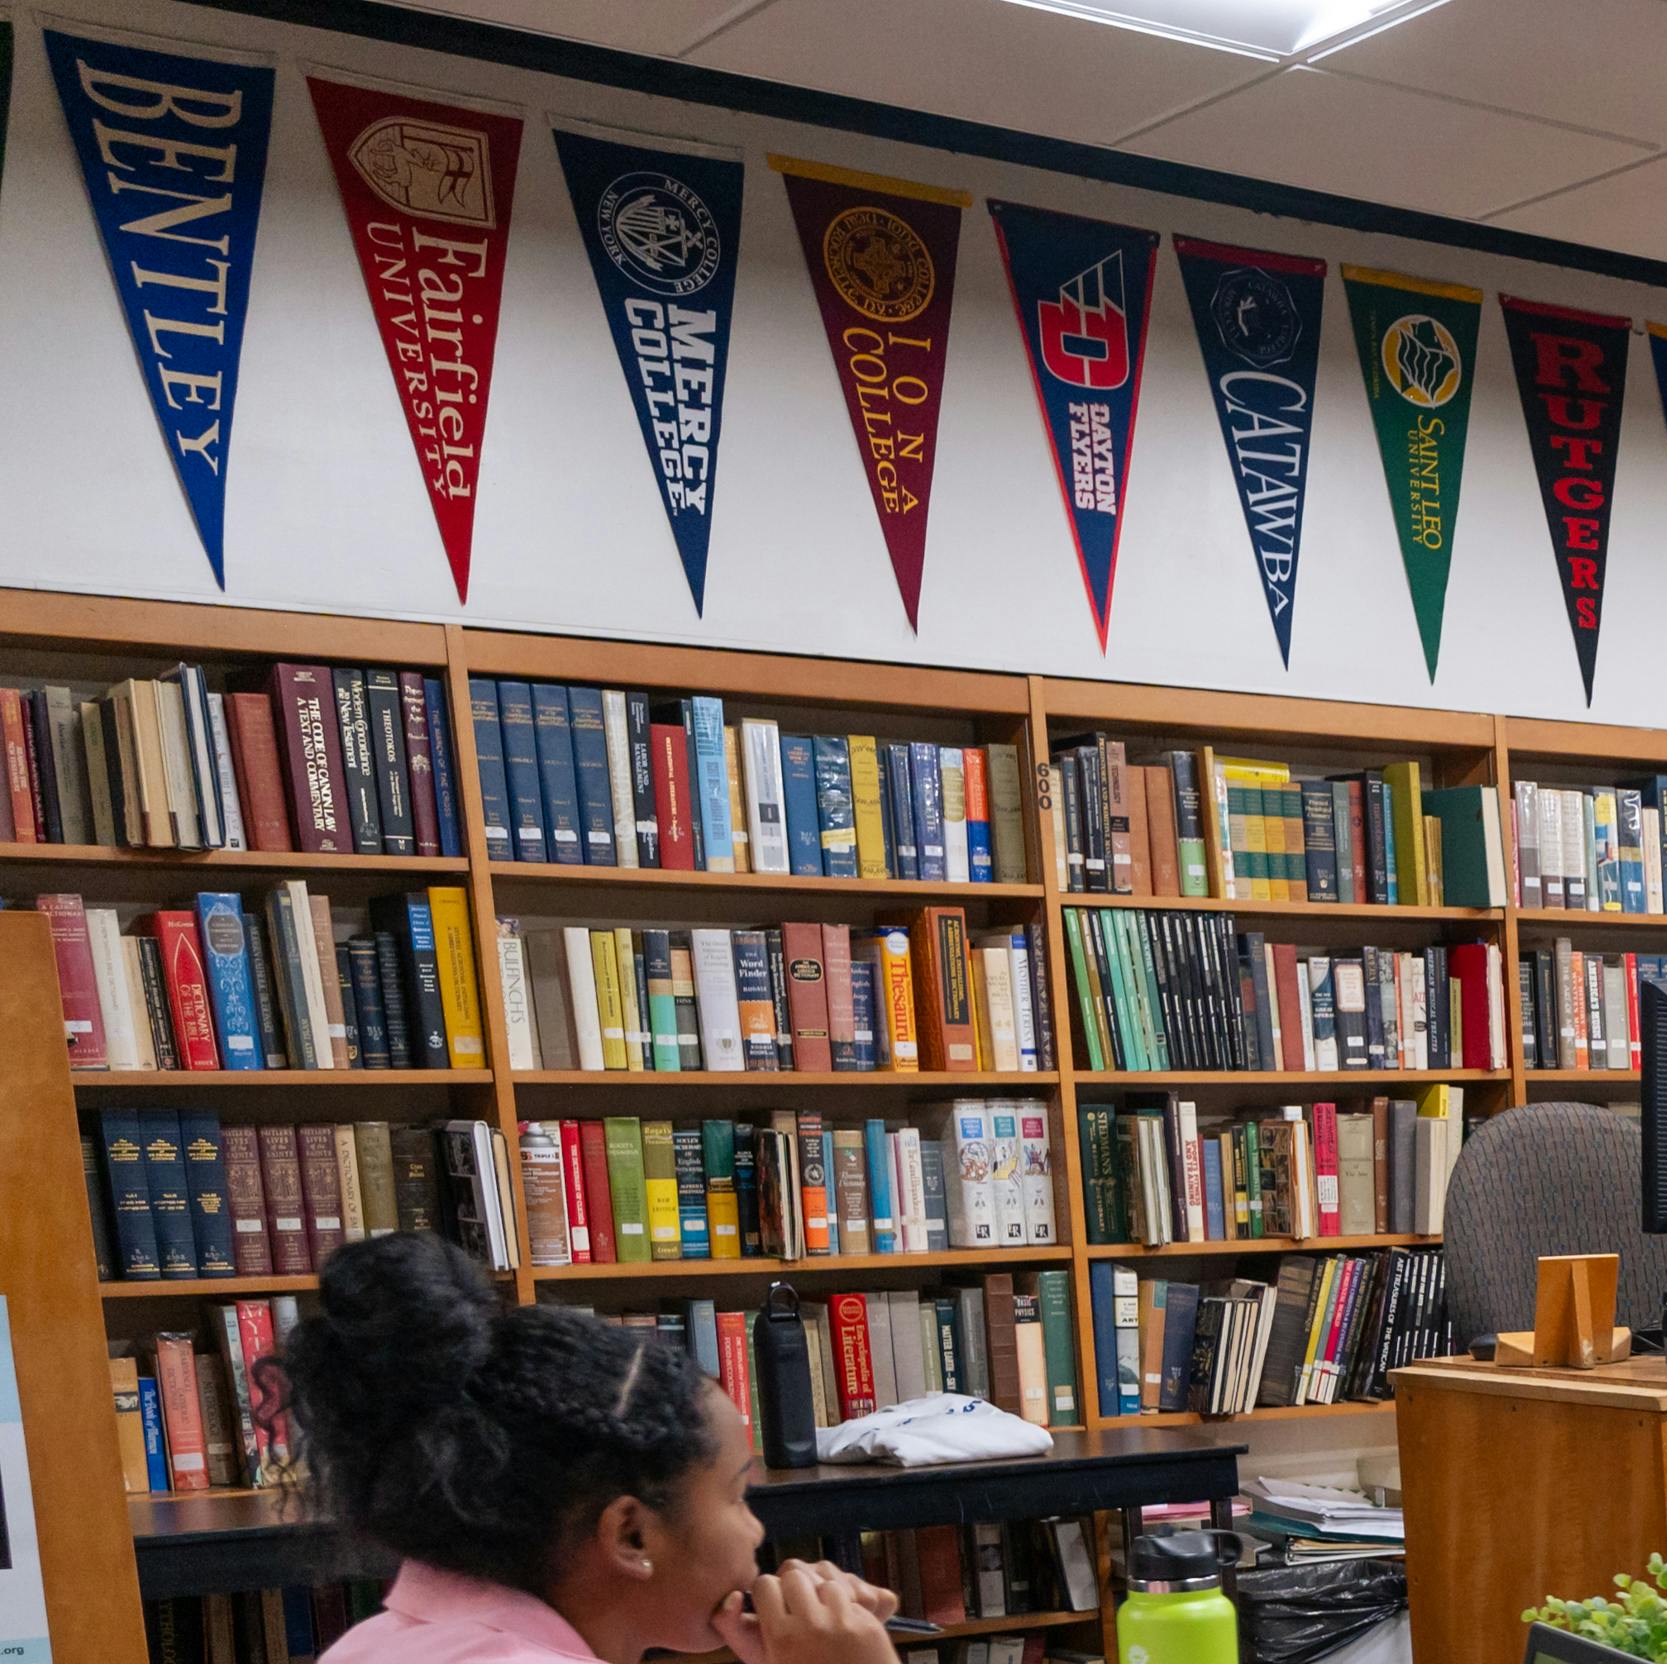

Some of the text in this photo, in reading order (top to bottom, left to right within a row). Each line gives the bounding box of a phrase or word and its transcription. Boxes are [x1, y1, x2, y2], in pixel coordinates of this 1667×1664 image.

[76, 58, 243, 476] BENTLEY
[600, 215, 625, 266] YORK
[664, 178, 721, 295] MERCY COLLEGE
[367, 221, 446, 498] UNIVERSITY
[411, 226, 488, 501] Fairfield
[624, 297, 687, 512] COLLEGE
[668, 303, 717, 516] MERCY
[844, 328, 899, 513] COLLEGE
[889, 332, 931, 514] IONA
[1069, 403, 1095, 510] FLYERS
[1089, 403, 1116, 515] DAYTON
[1219, 371, 1307, 616] CATAWBA
[1408, 430, 1424, 544] UNIVERSITY
[1417, 415, 1442, 549] SAINT LEO
[1531, 333, 1611, 629] RUTGERS
[297, 697, 325, 831] A TEXT AND COMMENTARY
[308, 698, 336, 832] THE CODE OF CANON LAW
[341, 700, 358, 768] New Testament
[351, 681, 371, 777] Modern Concordance
[382, 709, 395, 762] THEOTOKOS
[1037, 763, 1052, 810] 600
[180, 984, 191, 997] OF
[739, 960, 764, 969] Word
[739, 968, 767, 978] Finder
[891, 961, 909, 1042] Thesauru
[1017, 959, 1032, 1043] MOTHER TERESA
[184, 1002, 197, 1018] THE
[191, 984, 210, 1042] DICTIONARY
[227, 1137, 248, 1145] LIVES
[266, 1136, 289, 1144] LIVES
[306, 1136, 327, 1144] LIVES
[1097, 1112, 1111, 1175] STEDMAN'S
[1185, 1141, 1196, 1207] AND TRAINING
[1191, 1141, 1199, 1172] SPORTS
[941, 1325, 953, 1351] MATTER
[1379, 1257, 1404, 1373] ART TREASURES OF THE VATICAN
[841, 1326, 860, 1394] Literature
[857, 1325, 871, 1393] Encyclopedia of
